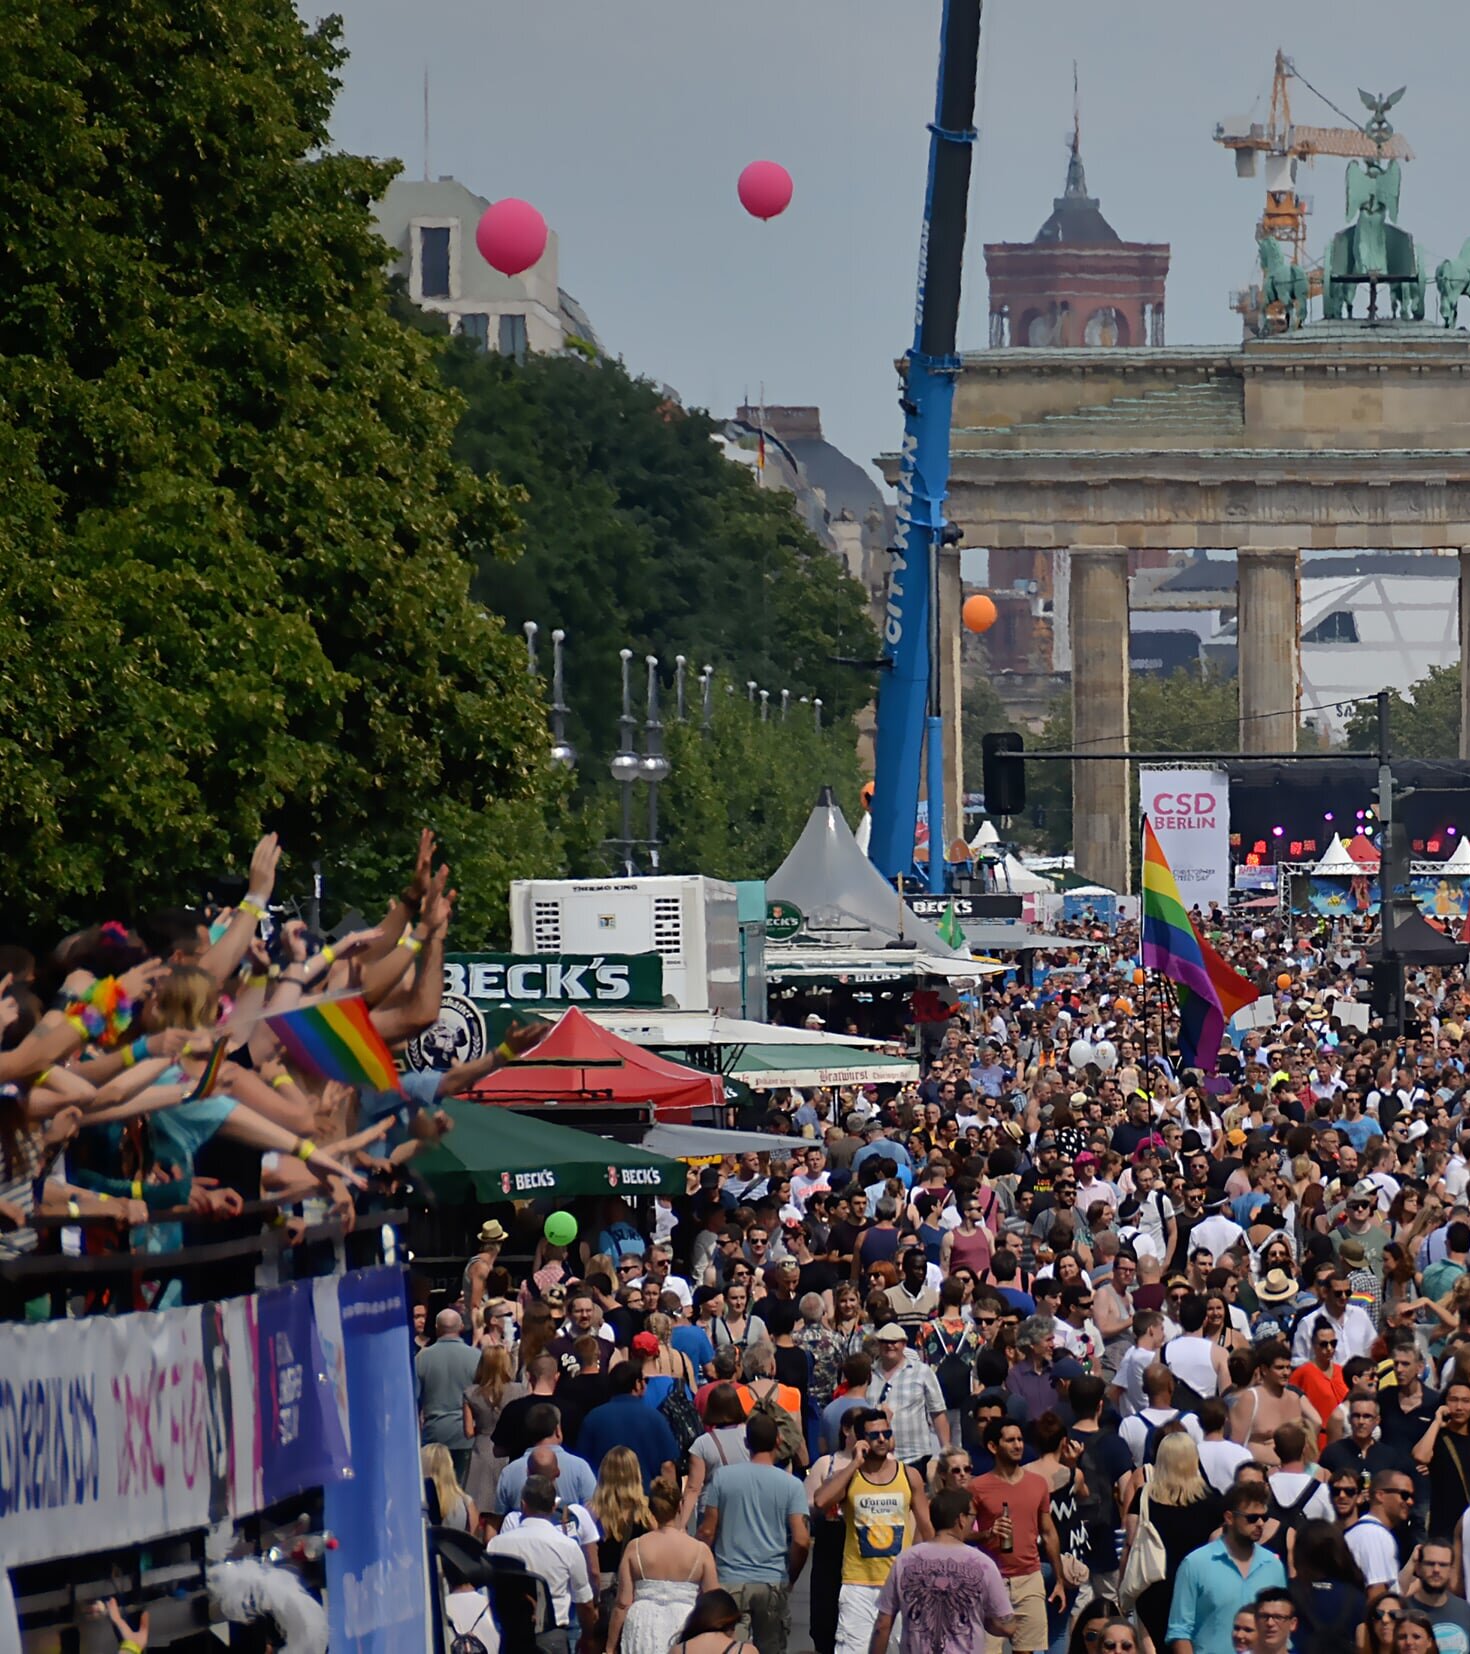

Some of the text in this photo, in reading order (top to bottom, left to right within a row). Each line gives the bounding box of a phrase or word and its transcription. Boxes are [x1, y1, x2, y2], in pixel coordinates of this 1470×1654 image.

[884, 431, 919, 645] CITYKRAN
[1153, 792, 1217, 816] CSD
[1154, 816, 1216, 830] BERLIN
[572, 884, 612, 892] THERMO
[766, 916, 799, 926] ECK'S
[443, 957, 631, 1000] BECK'S
[819, 1069, 869, 1083] Bratwurst
[515, 1168, 556, 1190] BECK'S
[621, 1166, 662, 1185] BECK'S
[859, 1497, 898, 1509] Corona
[870, 1506, 891, 1514] Extra
